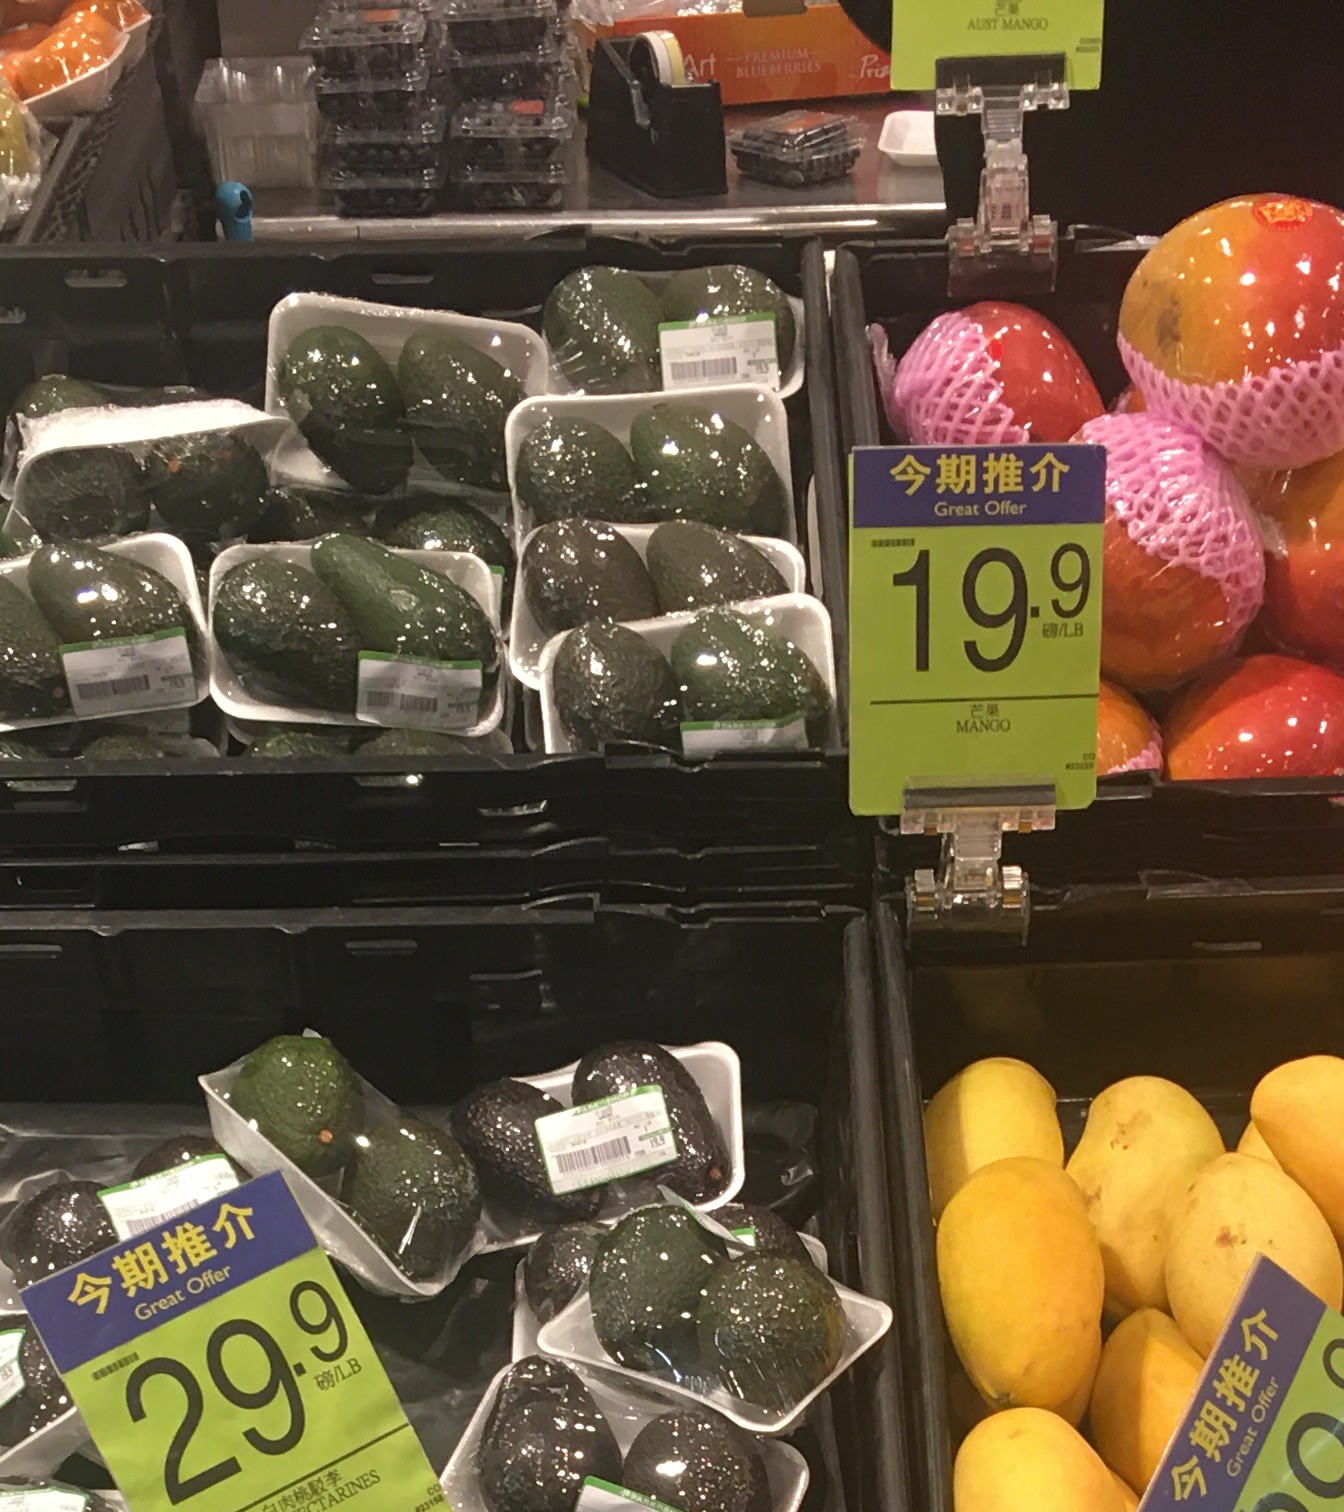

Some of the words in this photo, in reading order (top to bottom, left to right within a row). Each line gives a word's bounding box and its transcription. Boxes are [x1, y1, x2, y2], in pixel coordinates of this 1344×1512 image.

[967, 18, 998, 31] AUST
[1001, 18, 1049, 31] MANGO
[736, 61, 821, 79] BLUEBERRIES
[745, 48, 809, 63] PREMIUM
[889, 451, 1070, 496] 今期推介
[934, 502, 979, 517] Great
[985, 500, 1027, 516] Offer
[892, 542, 1091, 673] 19.9
[956, 718, 1011, 733] MANGO
[970, 703, 999, 719] 芒果
[66, 1201, 256, 1316] 今期推介
[135, 1288, 187, 1322] Great
[187, 1263, 233, 1297] Offer
[124, 1280, 349, 1507] 29.9
[1171, 1308, 1280, 1504] 今期推介
[1225, 1424, 1260, 1479] Great
[1250, 1375, 1280, 1427] Offer
